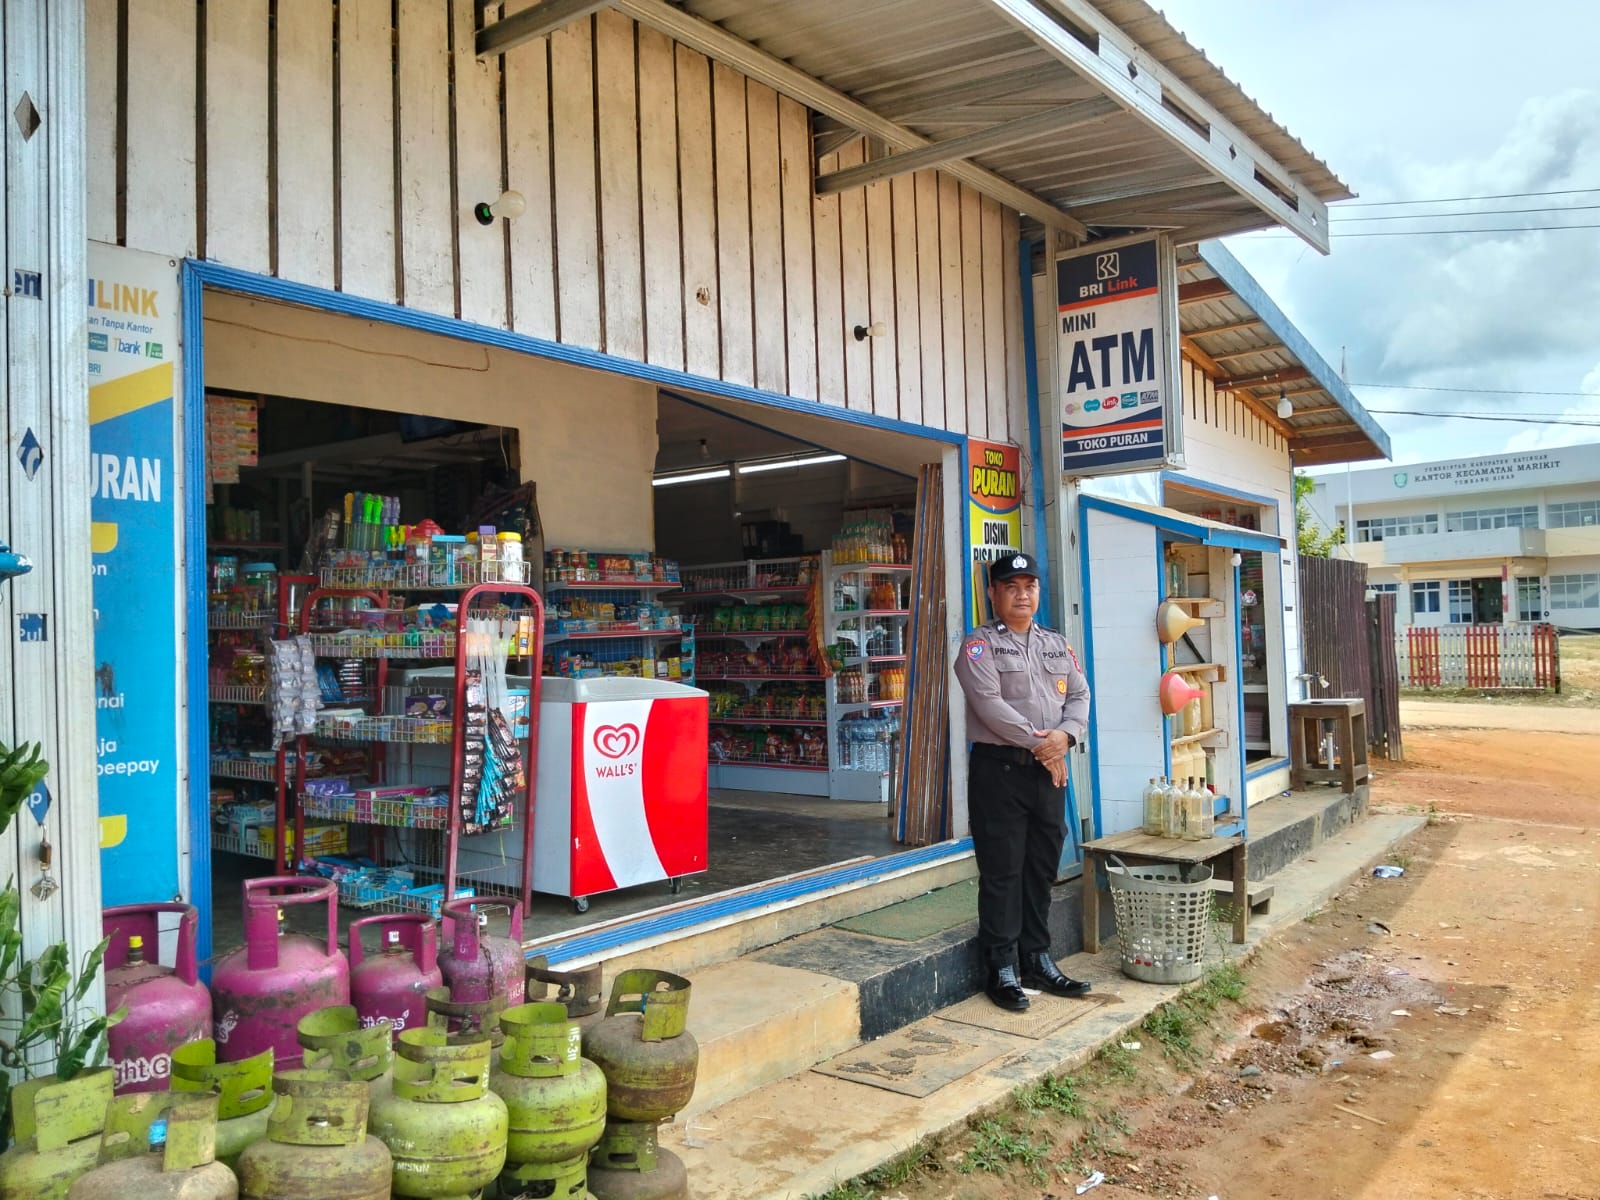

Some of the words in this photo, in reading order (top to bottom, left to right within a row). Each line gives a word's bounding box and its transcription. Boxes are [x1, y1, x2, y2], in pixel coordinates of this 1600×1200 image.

[1080, 282, 1103, 297] BRI
[1107, 276, 1138, 292] Link
[102, 317, 125, 330] Tanpa
[126, 321, 153, 334] Kantor
[1062, 311, 1096, 334] MINI
[1067, 328, 1155, 393] ATM
[1078, 438, 1107, 450] TOKO
[1110, 432, 1148, 447] PURAN
[984, 449, 1003, 467] TOKO
[1414, 472, 1452, 482] KANTOR
[1456, 465, 1513, 478] KECAMATAN
[1517, 460, 1561, 472] MARIKIT
[973, 466, 1017, 498] PURAN
[984, 522, 1009, 546] DISINI
[595, 763, 634, 778] WALL'S
